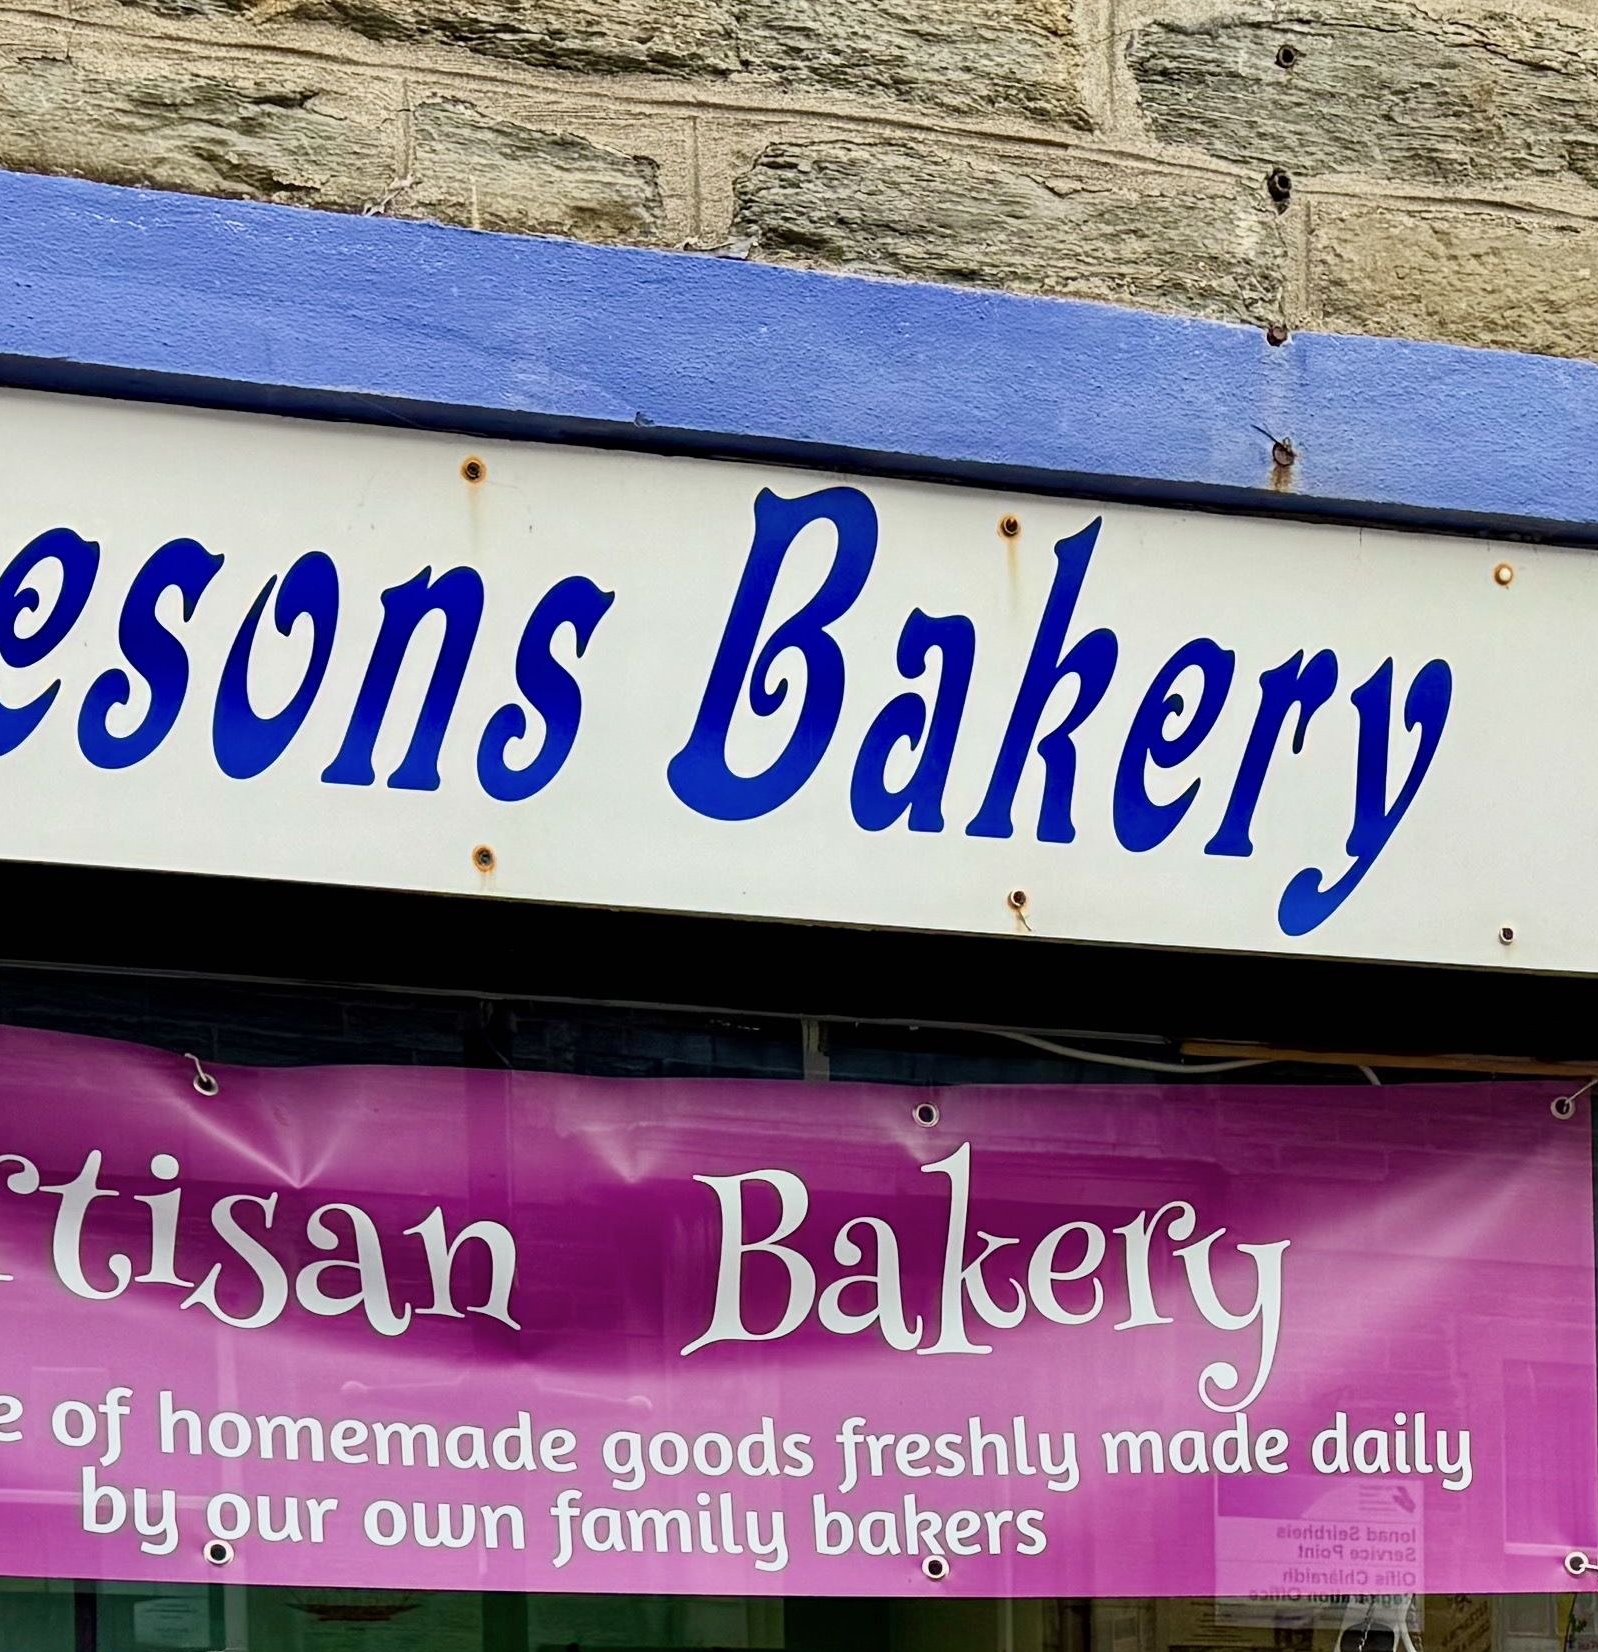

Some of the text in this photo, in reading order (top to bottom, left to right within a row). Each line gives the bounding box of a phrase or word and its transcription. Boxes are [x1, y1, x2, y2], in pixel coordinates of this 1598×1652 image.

[667, 487, 1452, 936] Bakery
[680, 1141, 1290, 1412] Bakery
[52, 1387, 133, 1466] of
[159, 1390, 577, 1472] homemade
[602, 1417, 813, 1491] goods
[838, 1415, 1080, 1492] freshly
[1104, 1414, 1289, 1475] made
[1310, 1410, 1473, 1492] daily
[81, 1464, 1047, 1569] by our own family bakers
